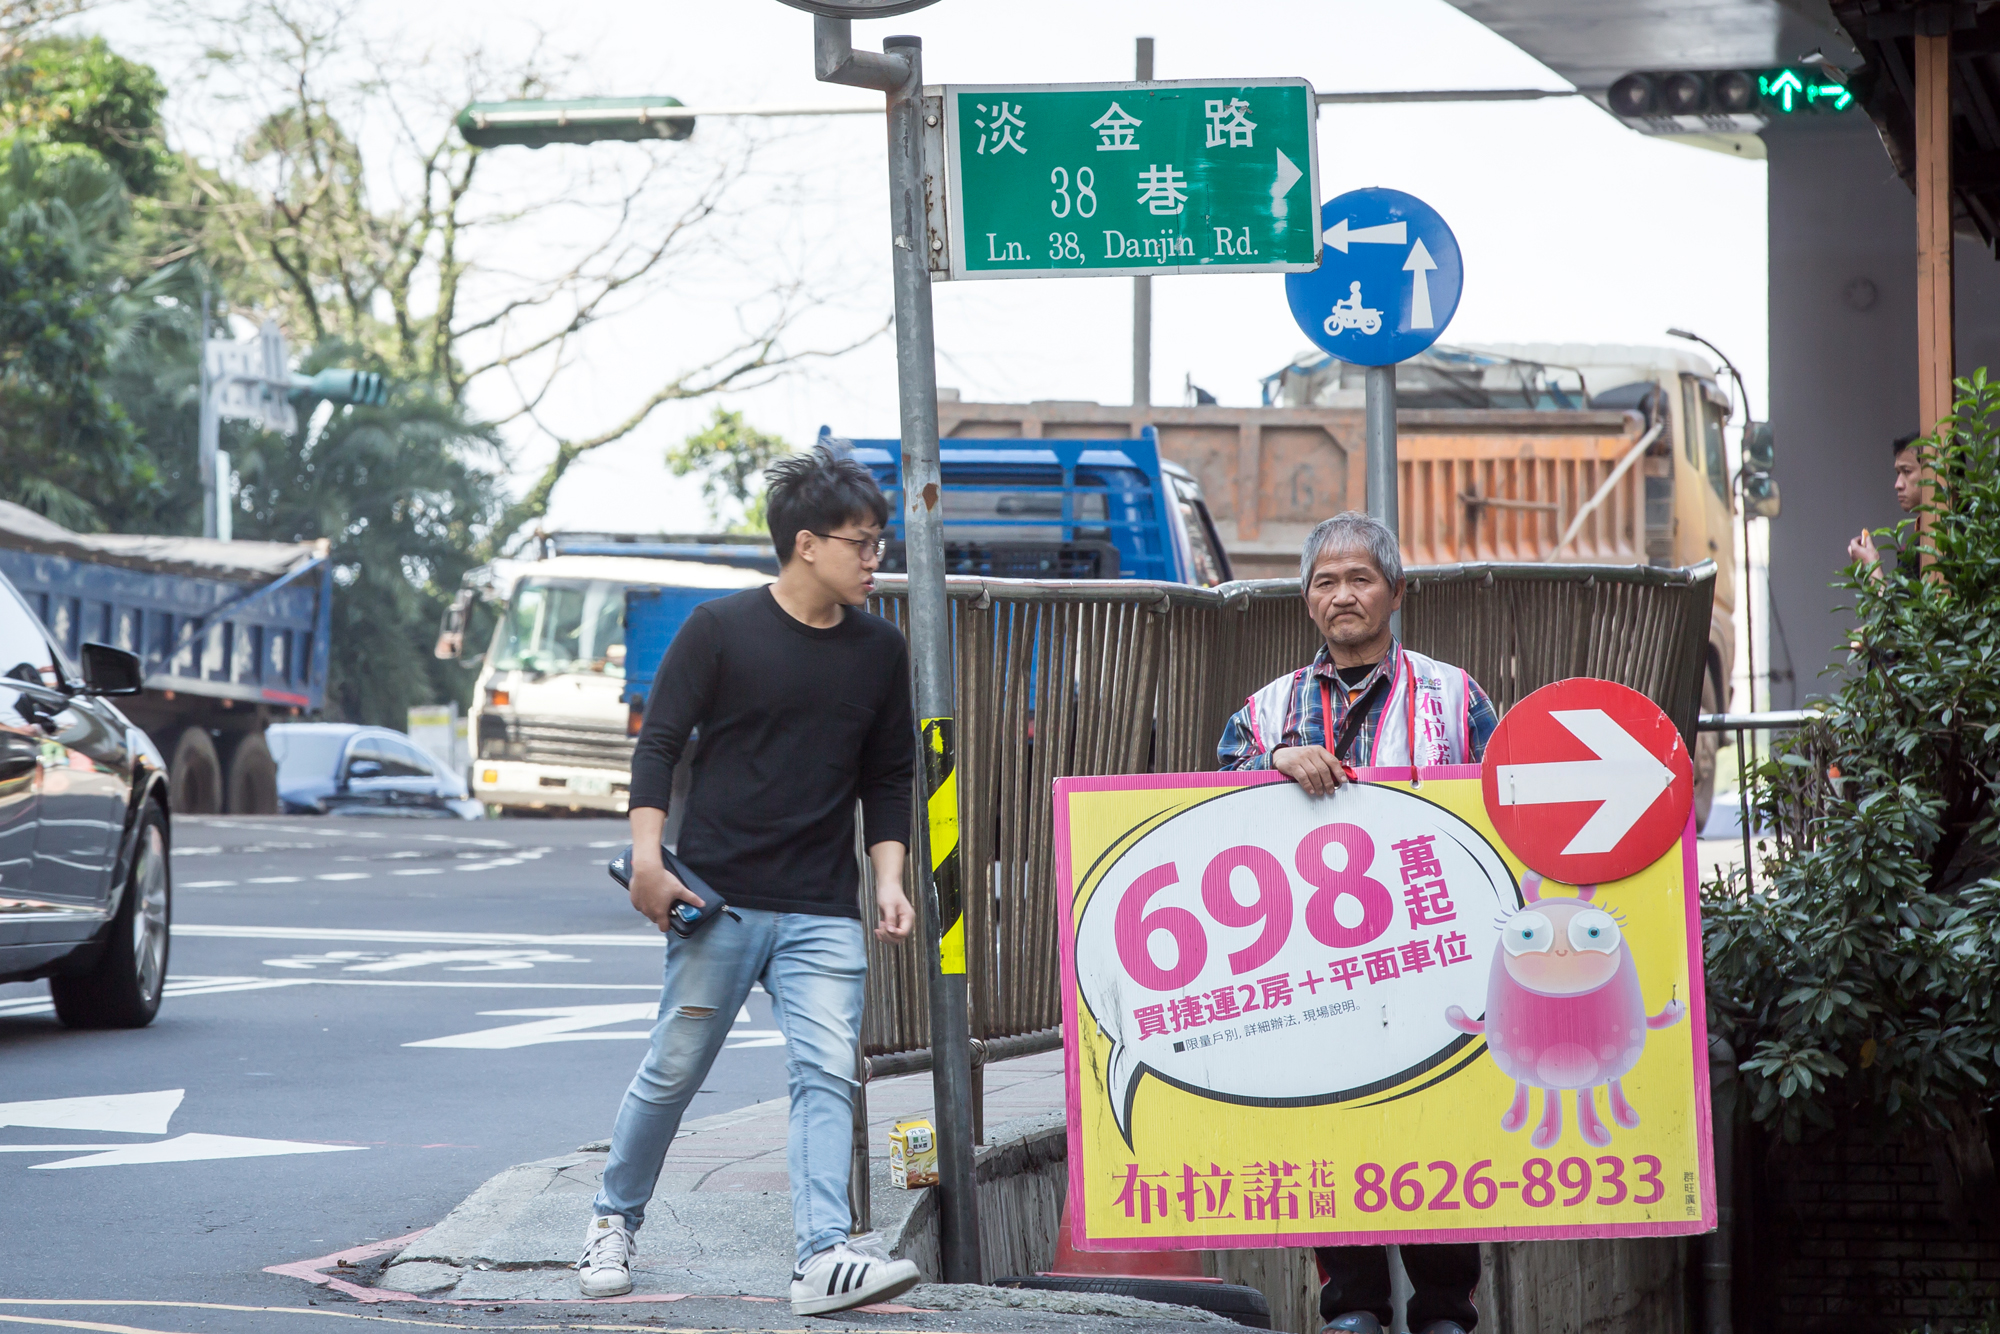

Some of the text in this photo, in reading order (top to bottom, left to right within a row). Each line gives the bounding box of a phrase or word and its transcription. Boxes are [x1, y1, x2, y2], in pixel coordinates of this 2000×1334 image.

[975, 98, 1257, 155] 淡金路
[987, 226, 1259, 265] Ln. 38, Danjin Rd.
[1114, 822, 1394, 992] 698
[1113, 1153, 1665, 1224] 布拉諾 花園 8626-8933
